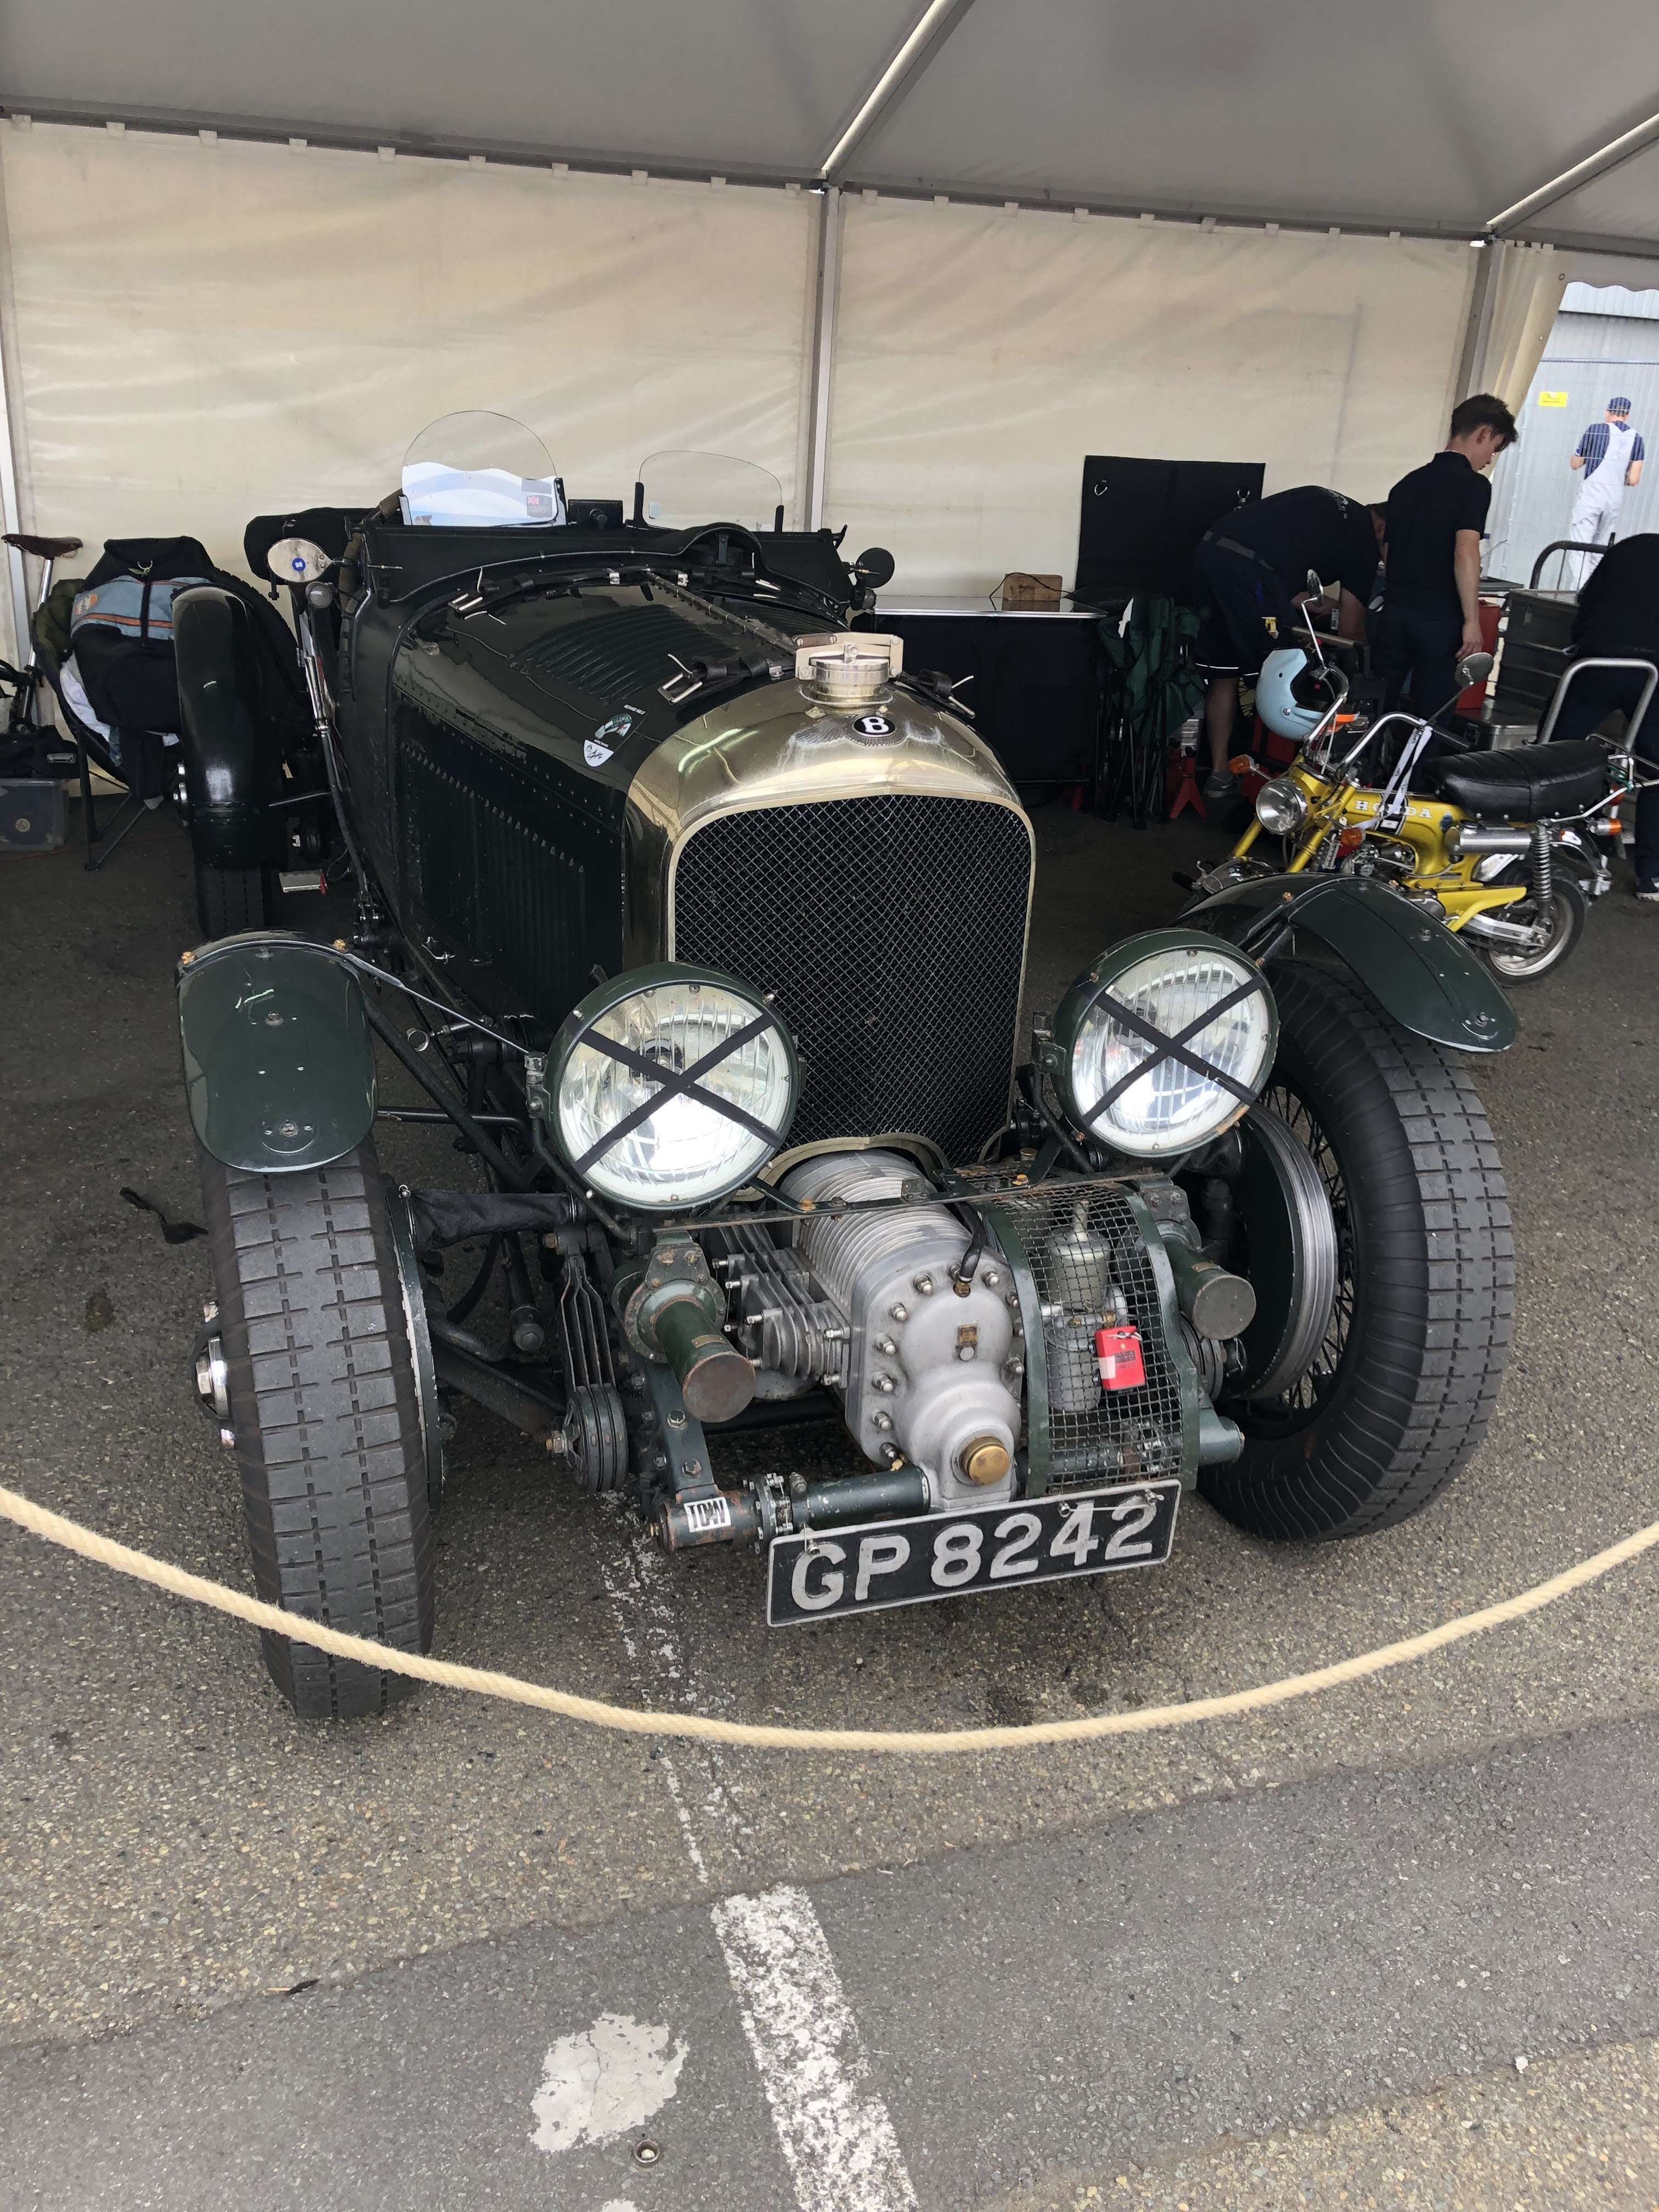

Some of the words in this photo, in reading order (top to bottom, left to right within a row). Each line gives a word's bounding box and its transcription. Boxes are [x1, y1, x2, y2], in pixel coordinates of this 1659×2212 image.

[861, 716, 889, 733] B
[688, 1500, 726, 1527] TOW
[791, 1534, 911, 1610] GP
[931, 1494, 1157, 1588] 8242
